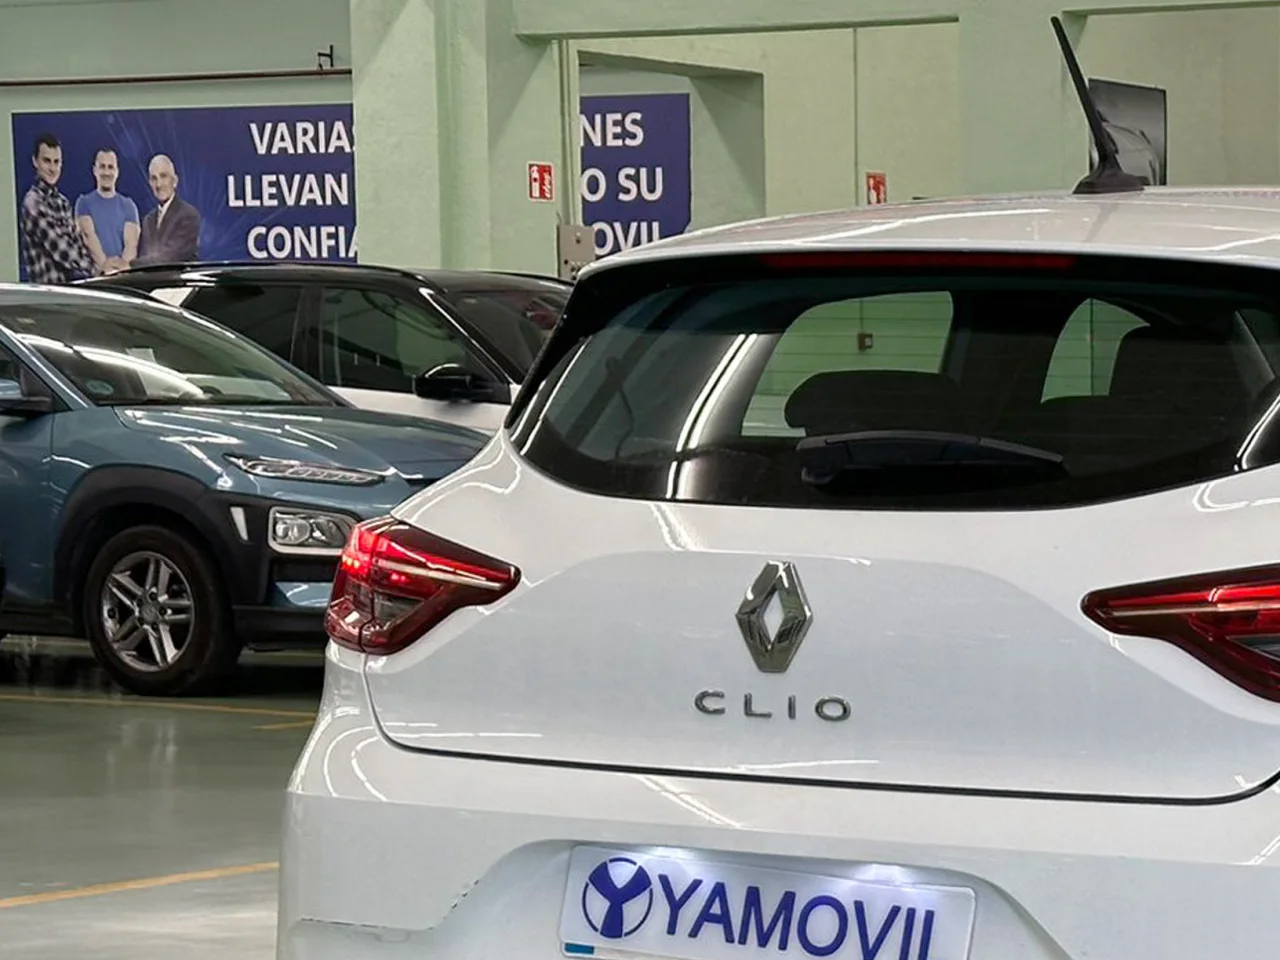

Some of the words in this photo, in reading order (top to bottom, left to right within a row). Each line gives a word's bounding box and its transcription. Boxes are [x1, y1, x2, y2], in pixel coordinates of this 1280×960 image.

[250, 121, 357, 154] VARIA
[227, 173, 348, 207] LLEVAN
[617, 167, 663, 202] SU
[694, 690, 852, 721] CLIO
